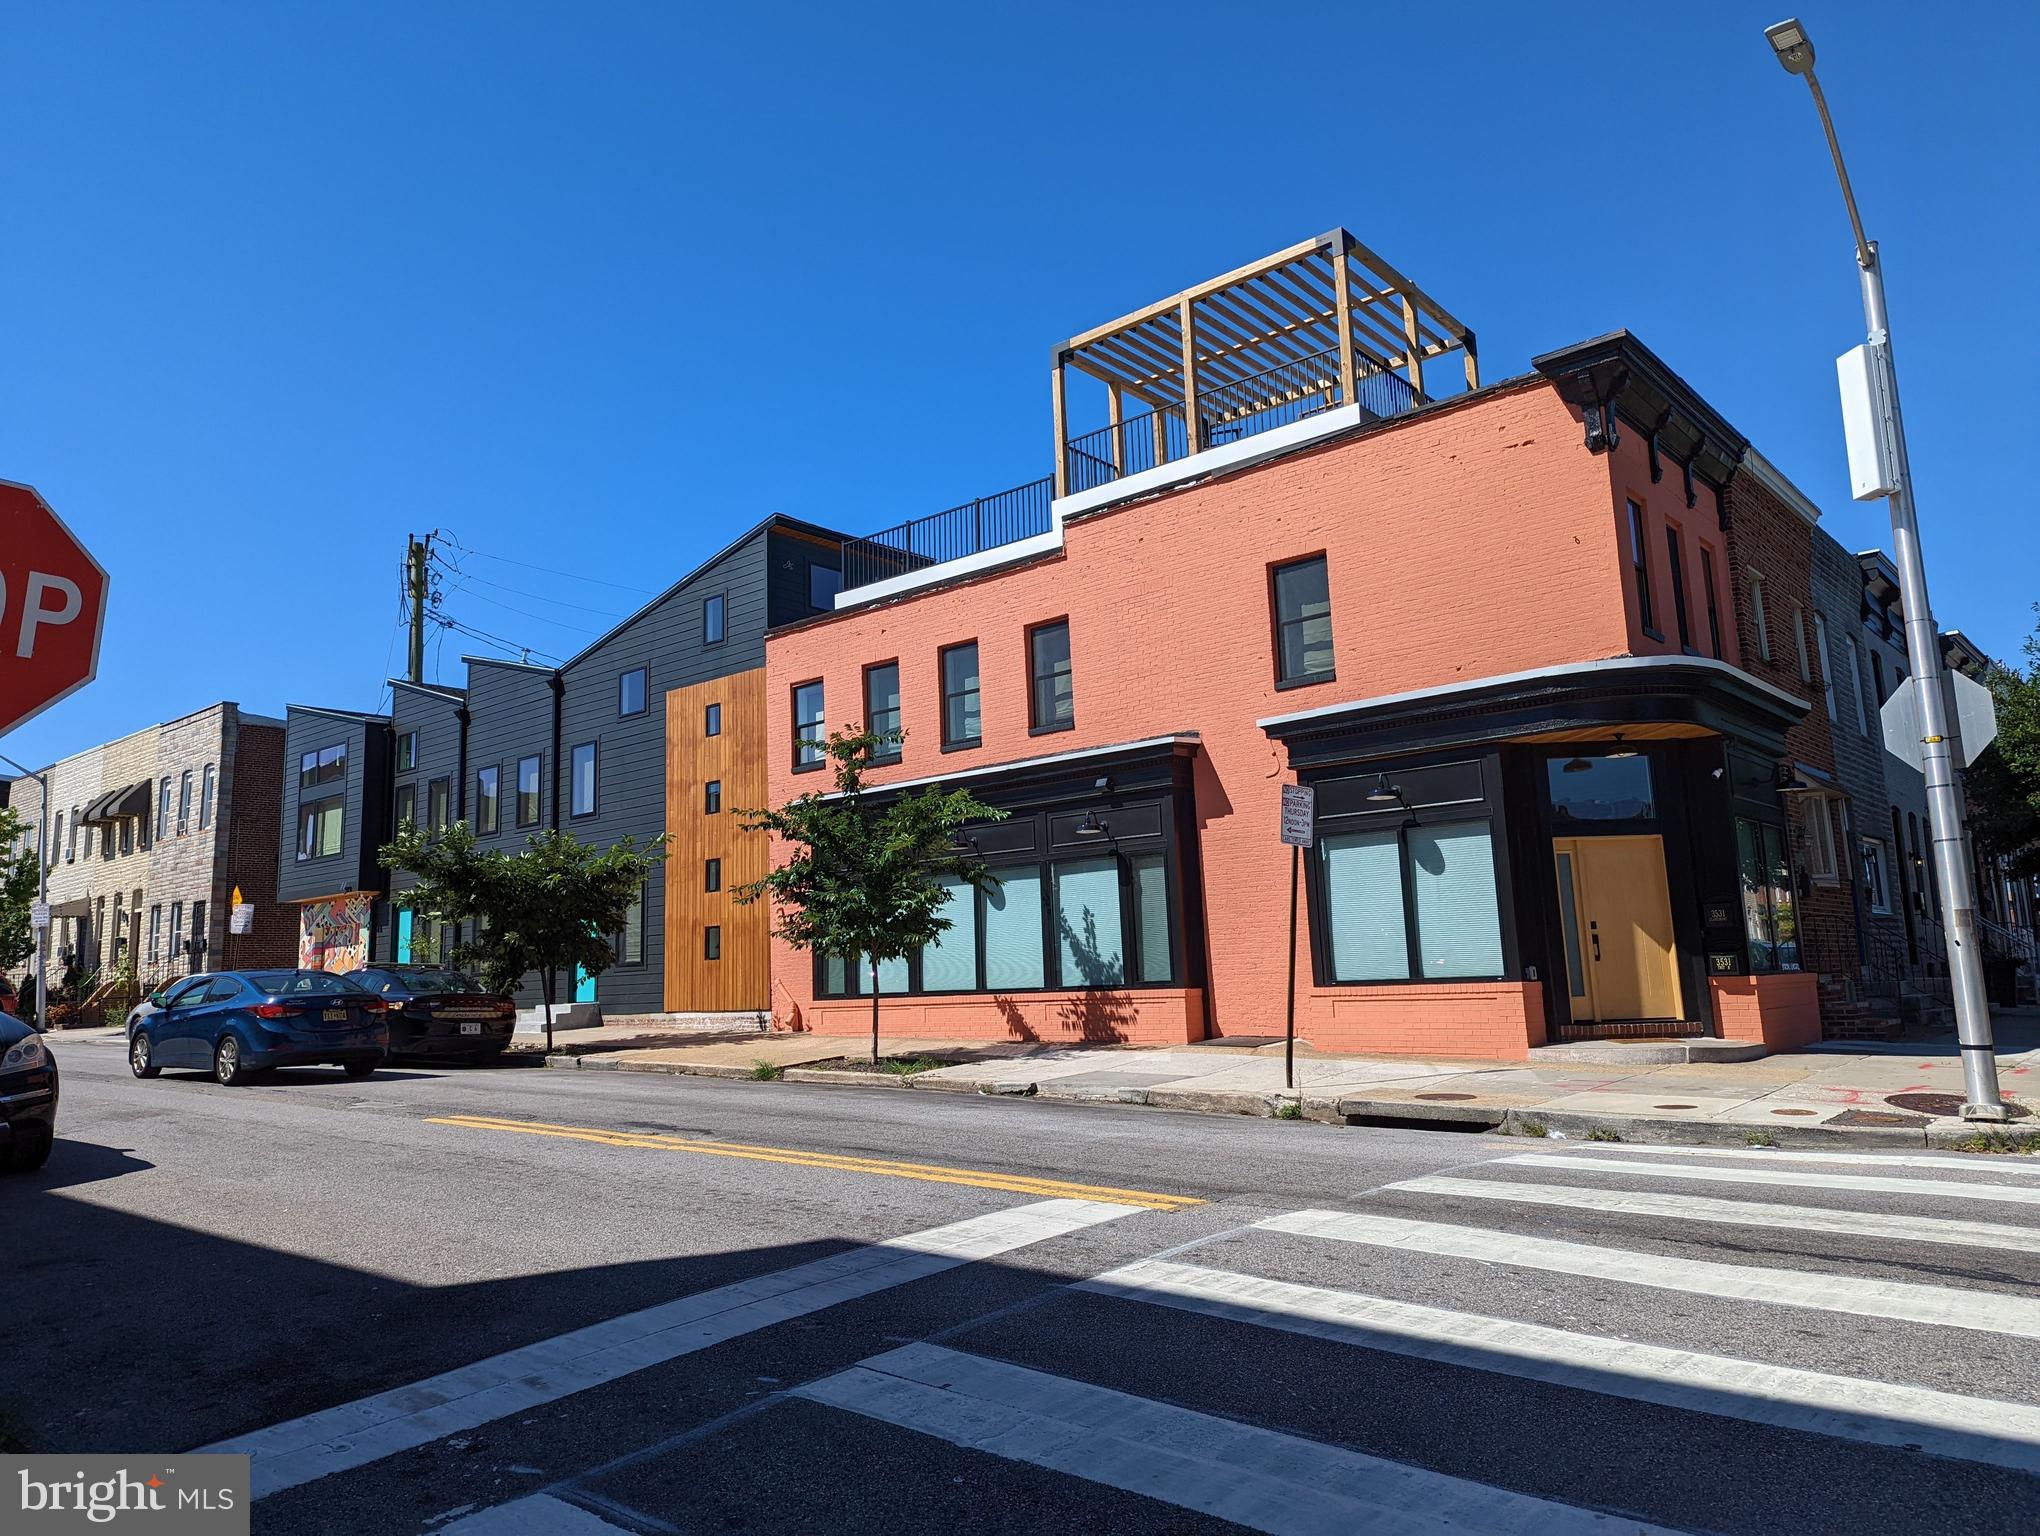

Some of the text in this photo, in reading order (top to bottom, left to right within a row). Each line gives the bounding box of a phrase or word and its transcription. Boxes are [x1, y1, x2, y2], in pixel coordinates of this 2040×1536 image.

[1289, 786, 1311, 797] STOPPING
[1290, 800, 1311, 810] PARKING
[1284, 806, 1310, 818] THURSDAY
[1711, 910, 1726, 918] 3531
[1716, 958, 1732, 966] 3531
